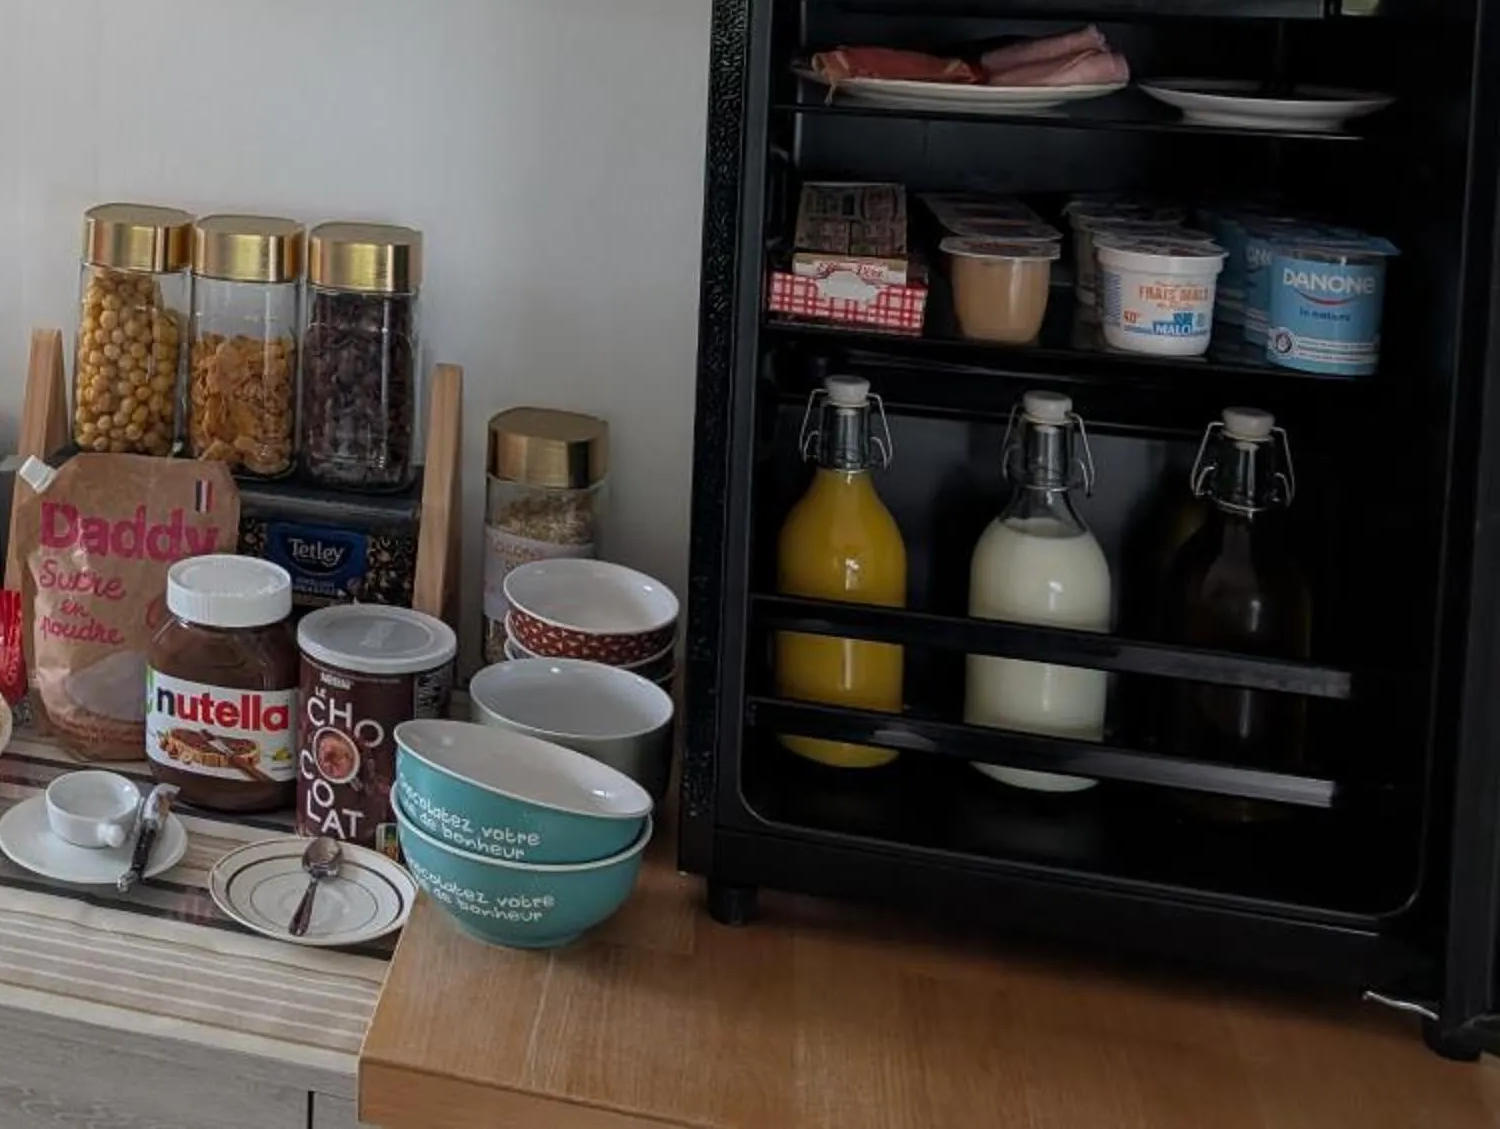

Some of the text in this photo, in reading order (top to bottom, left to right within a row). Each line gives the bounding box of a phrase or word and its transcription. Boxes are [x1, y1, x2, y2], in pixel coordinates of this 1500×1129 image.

[1283, 267, 1376, 296] DANONE
[39, 502, 219, 563] Daddy
[287, 537, 346, 568] Tetley
[39, 558, 126, 600] Sucre
[60, 598, 89, 618] en
[39, 616, 125, 645] poudre
[156, 686, 290, 732] nutella
[441, 821, 526, 860] bonheur
[480, 825, 542, 847] votre
[496, 894, 556, 910] votre
